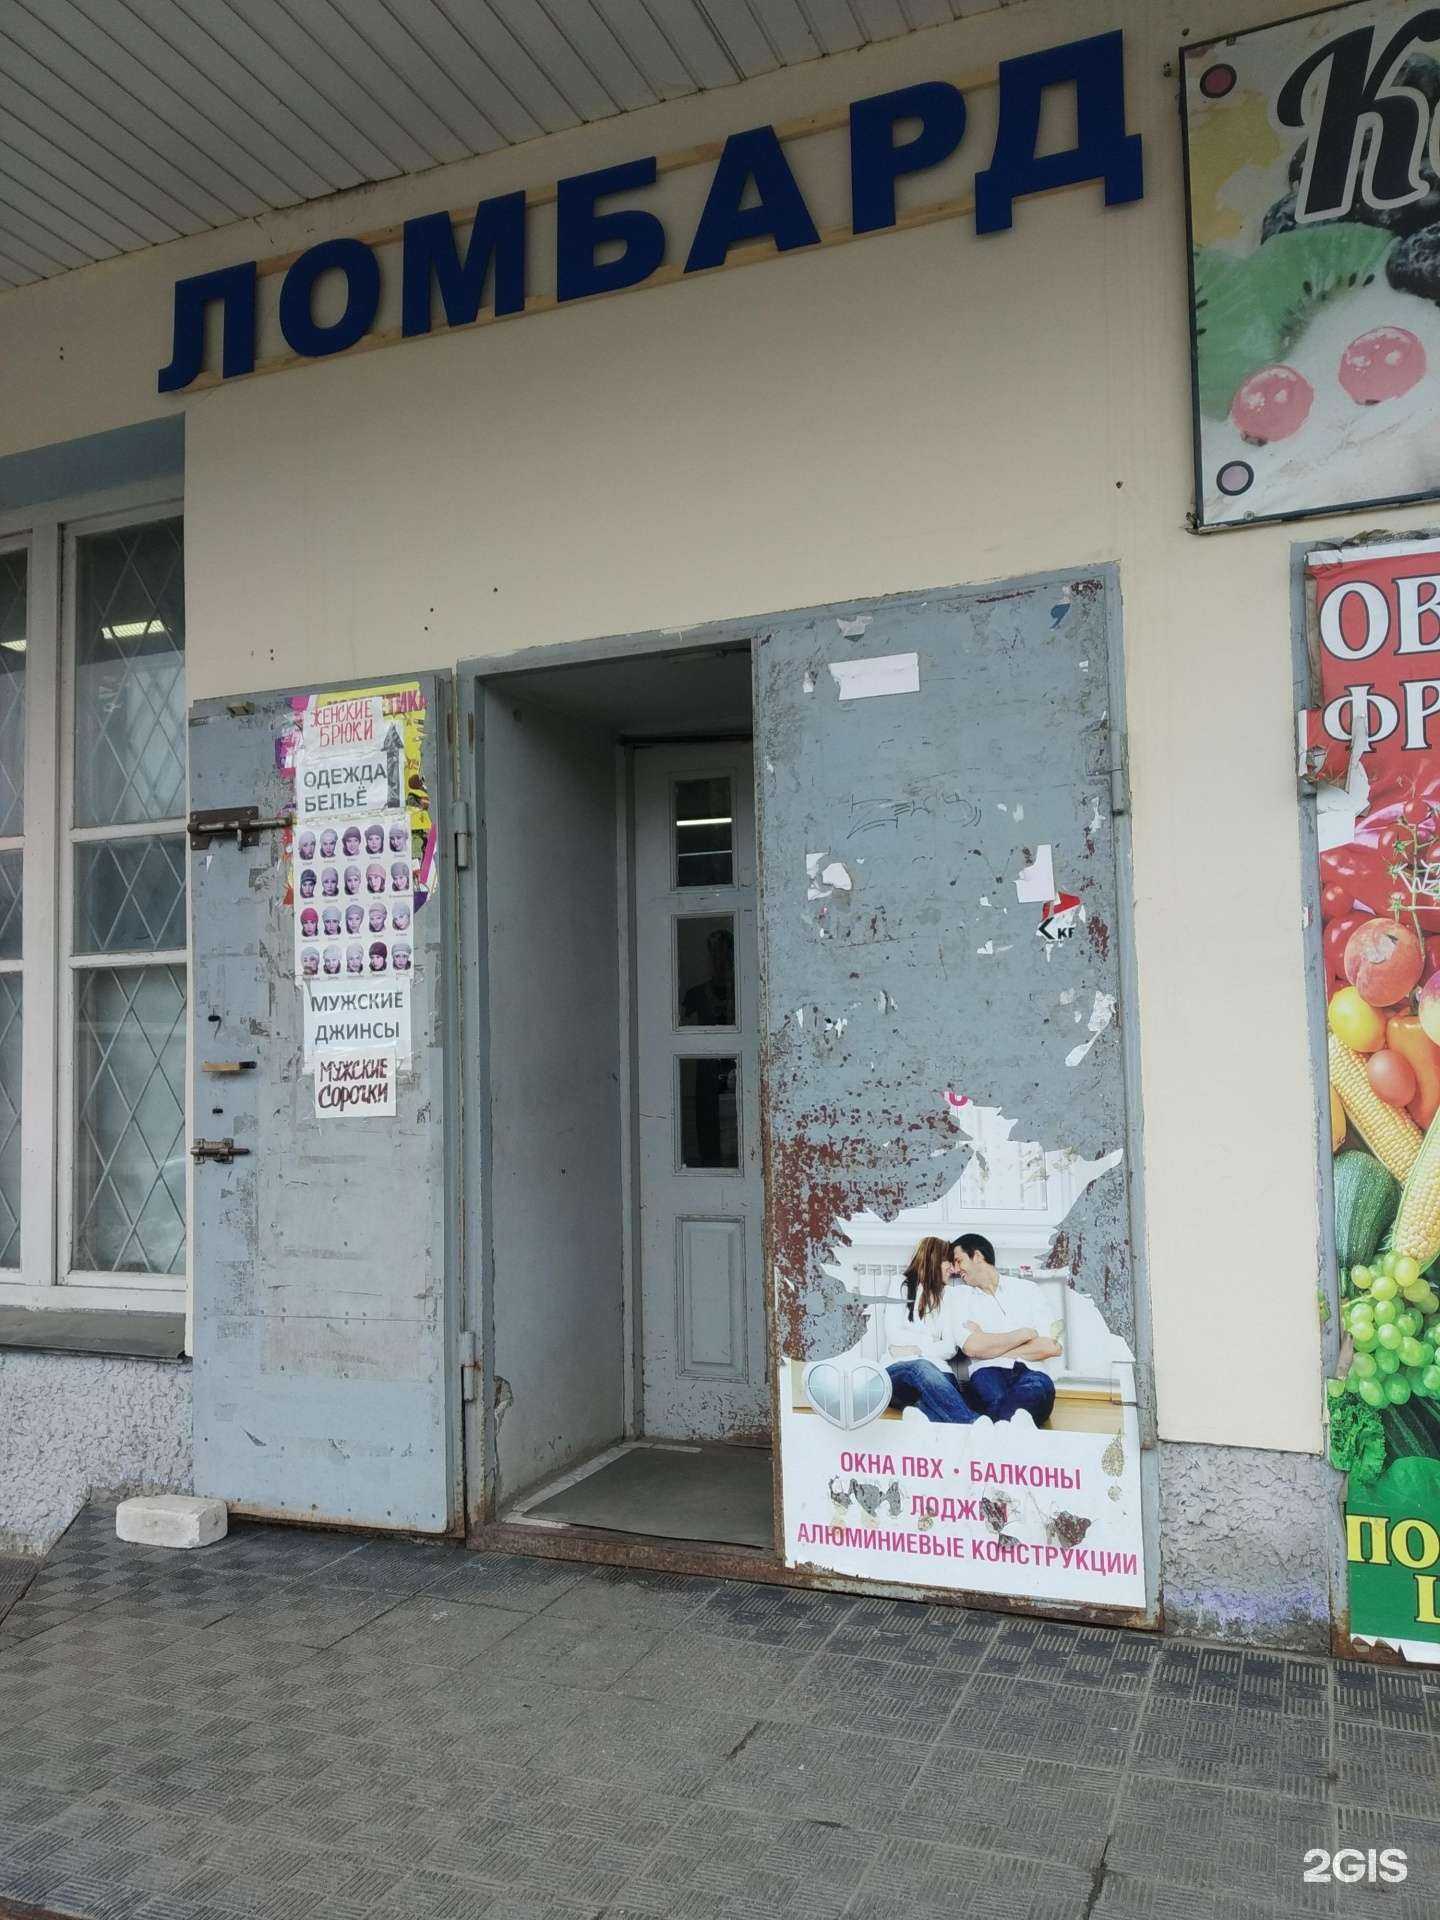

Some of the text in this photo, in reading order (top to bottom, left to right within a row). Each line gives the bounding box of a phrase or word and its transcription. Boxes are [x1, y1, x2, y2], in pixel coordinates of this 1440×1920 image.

[1277, 8, 1440, 214] К
[158, 29, 1143, 393] ЛОМБАРД
[310, 700, 373, 728] ЖЕНСКИЕ
[319, 719, 373, 747] БРЮКИ
[303, 763, 387, 790] ОДЕЖДА
[304, 786, 368, 813] БЕЛЬЁ
[311, 991, 404, 1012] МУЖСКИЕ
[315, 1021, 400, 1045] ДЖИНСЫ
[319, 1058, 388, 1082] МУЖСКИЕ
[840, 1451, 1081, 1490] ОКНА ПВХ БАЛКОНЫ
[797, 1523, 1137, 1576] АЛЮМИНИЕВЫЕ КОНСТРУКЦИИ
